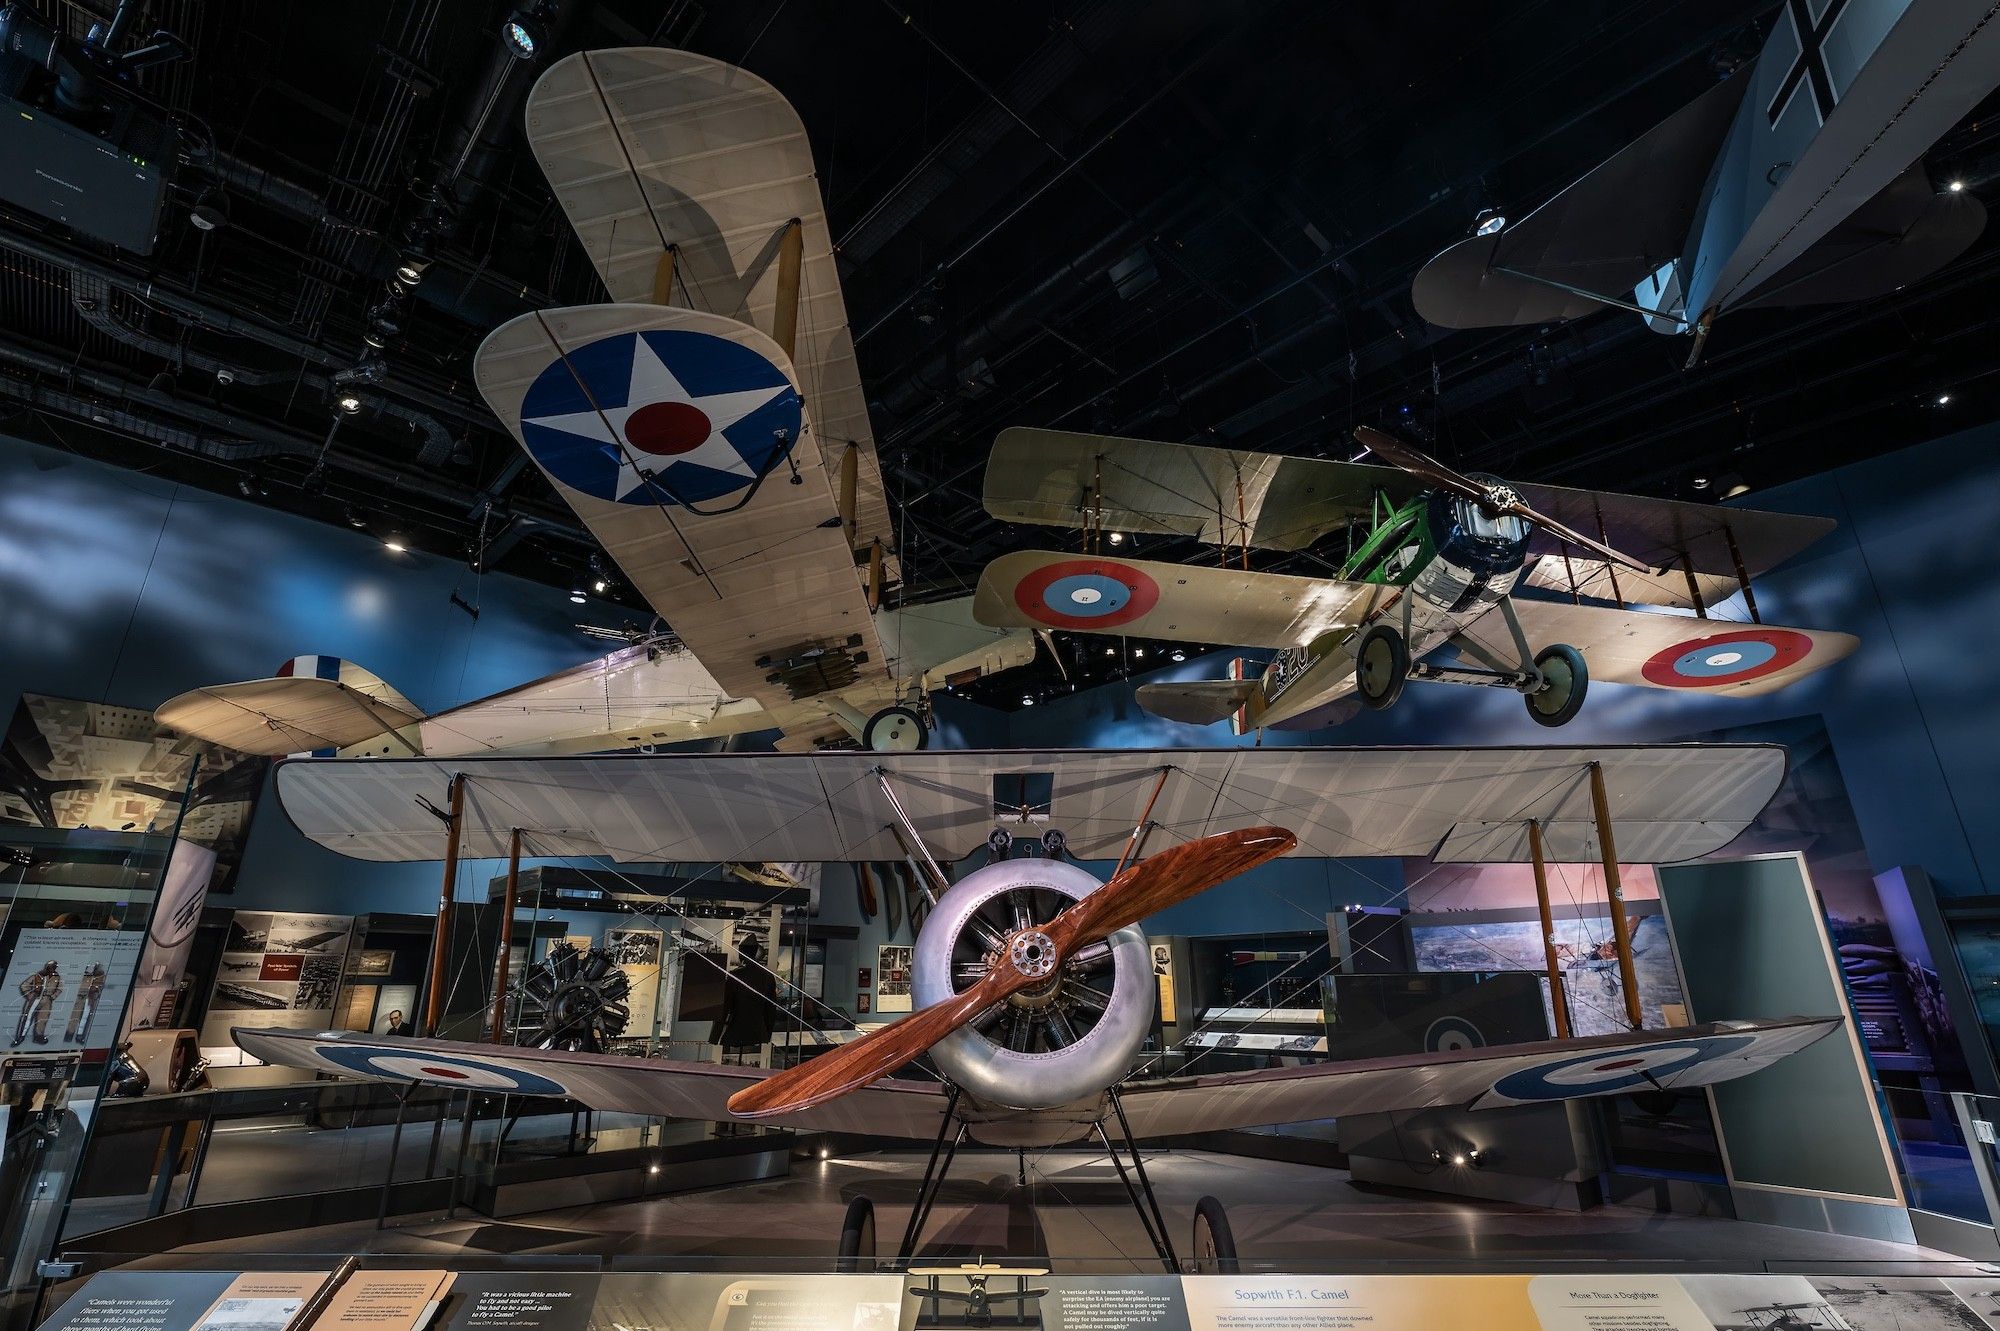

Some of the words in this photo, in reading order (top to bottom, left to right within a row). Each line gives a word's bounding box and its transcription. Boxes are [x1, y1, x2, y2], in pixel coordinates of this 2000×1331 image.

[1234, 1289, 1284, 1302] Sopwith
[1287, 1289, 1307, 1300] F.1.
[1310, 1289, 1350, 1300] Camel
[1569, 1291, 1591, 1300] More
[1591, 1291, 1613, 1300] Than
[1613, 1291, 1620, 1300] a
[1619, 1291, 1660, 1300] Dogfighter
[117, 1298, 135, 1306] were
[135, 1298, 176, 1306] wonderful
[100, 1308, 121, 1316] when
[119, 1308, 137, 1316] you
[149, 1308, 169, 1316] used
